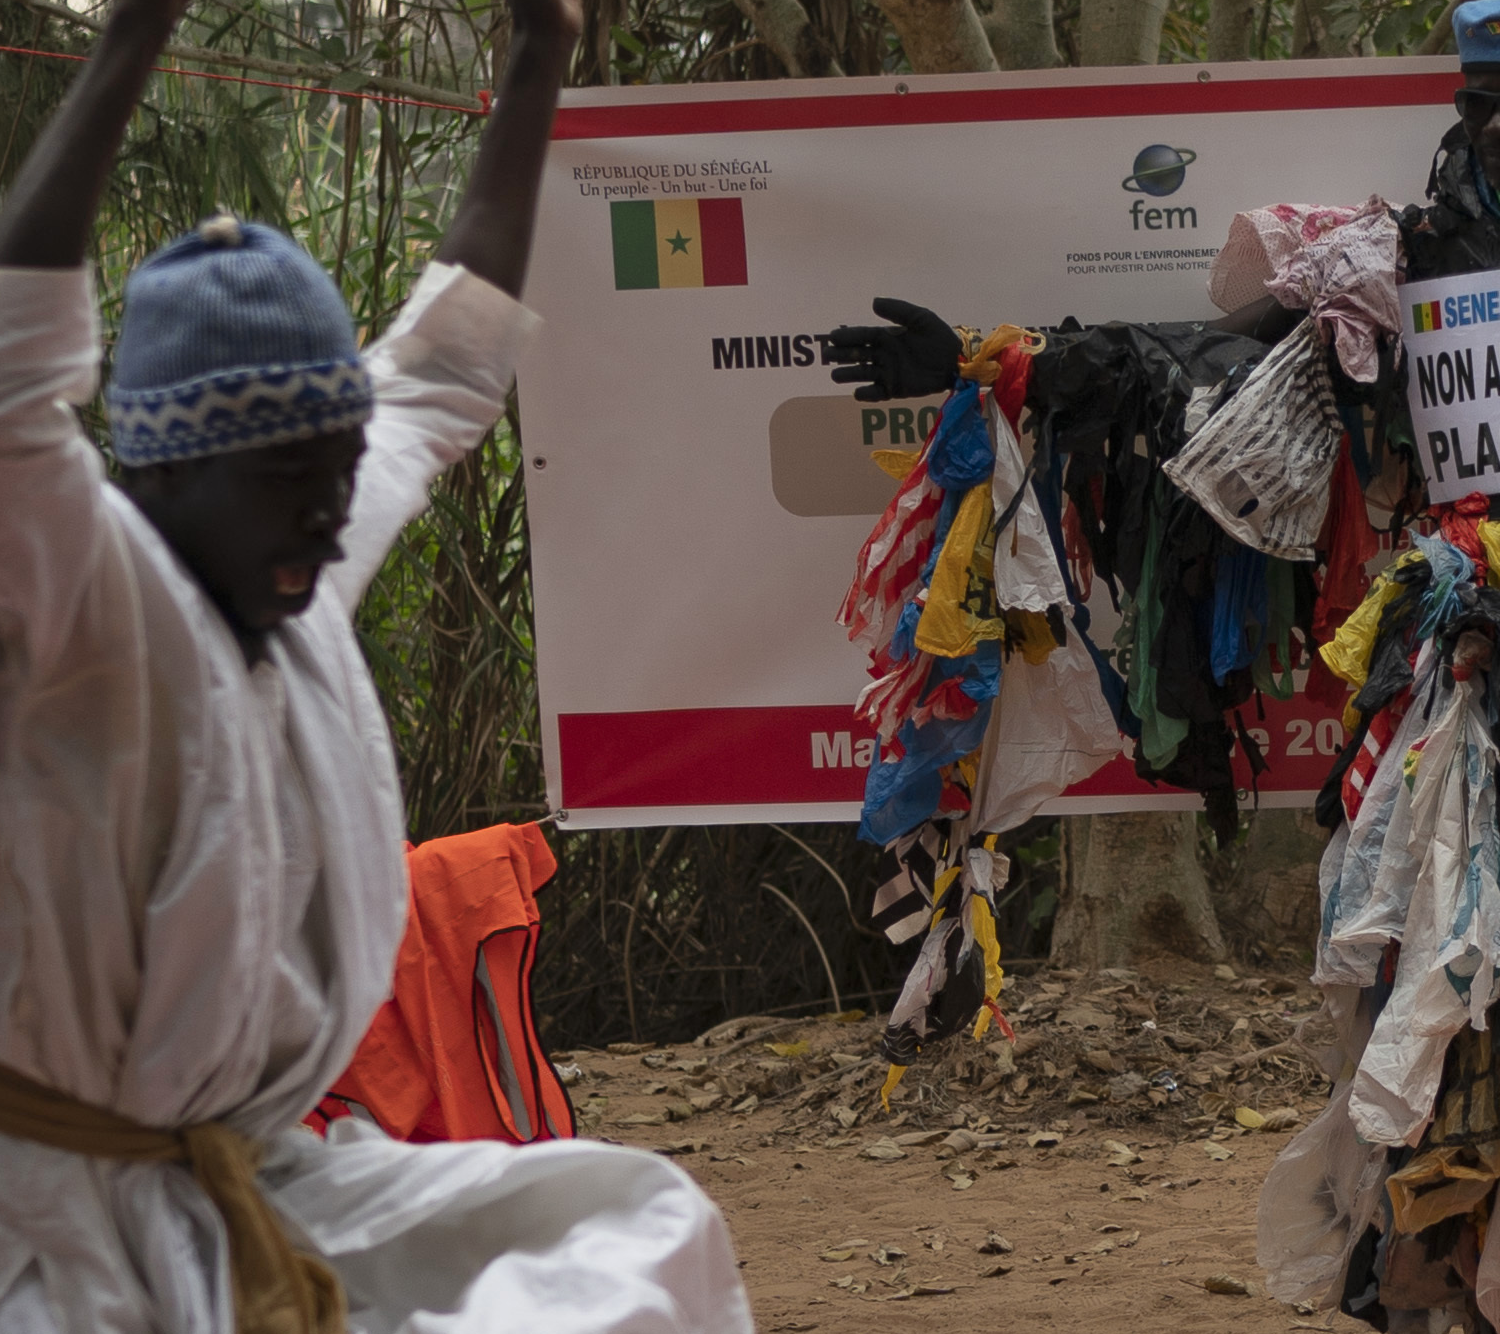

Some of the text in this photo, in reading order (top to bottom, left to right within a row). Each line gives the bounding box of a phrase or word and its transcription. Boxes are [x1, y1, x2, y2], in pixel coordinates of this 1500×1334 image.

[573, 158, 772, 182] RÉPUBLIQUE DU SÉNÉGAL
[580, 183, 601, 197] Un
[603, 180, 649, 199] peuple
[660, 181, 681, 194] Un
[684, 179, 707, 193] but
[718, 178, 747, 192] Une
[750, 177, 768, 191] foi
[1129, 199, 1198, 230] fem
[1066, 253, 1101, 262] FONDS
[1104, 251, 1132, 261] POUR
[1067, 261, 1210, 275] POUR INVESTIR DANS NOTRE
[1416, 348, 1476, 409] NON
